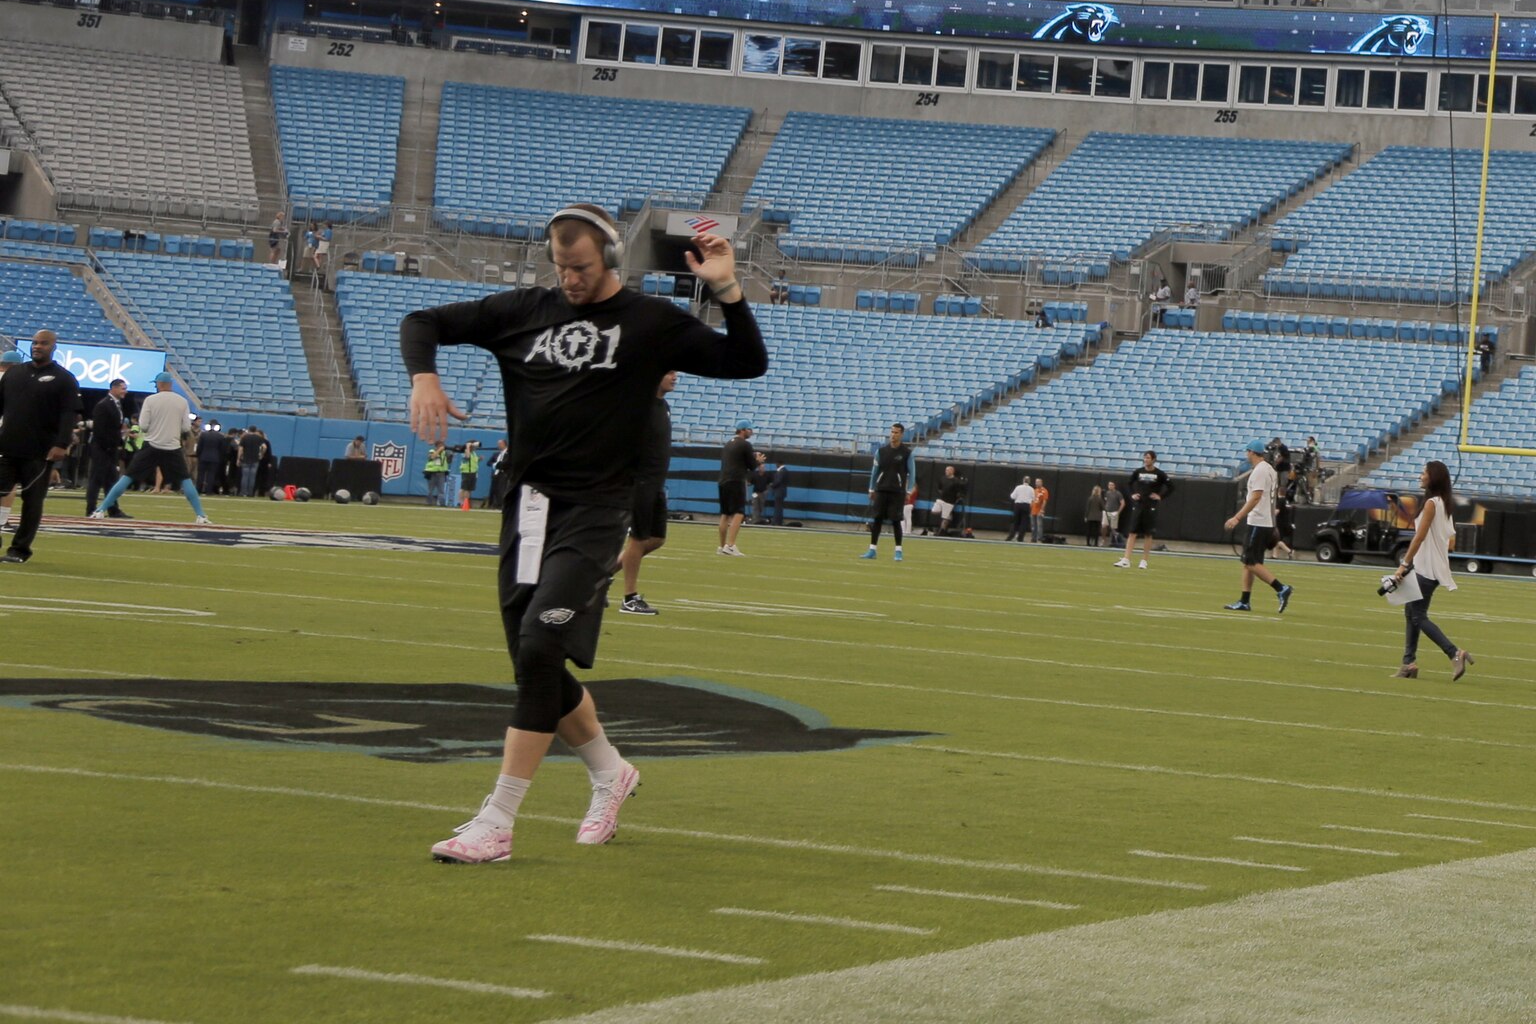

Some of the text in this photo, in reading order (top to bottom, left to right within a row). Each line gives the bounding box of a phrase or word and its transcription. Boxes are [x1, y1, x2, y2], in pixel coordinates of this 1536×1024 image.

[77, 13, 101, 29] 351
[328, 42, 355, 58] 252
[594, 68, 619, 82] 253
[916, 93, 940, 107] 254
[1215, 110, 1239, 124] 255
[66, 350, 133, 383] belk
